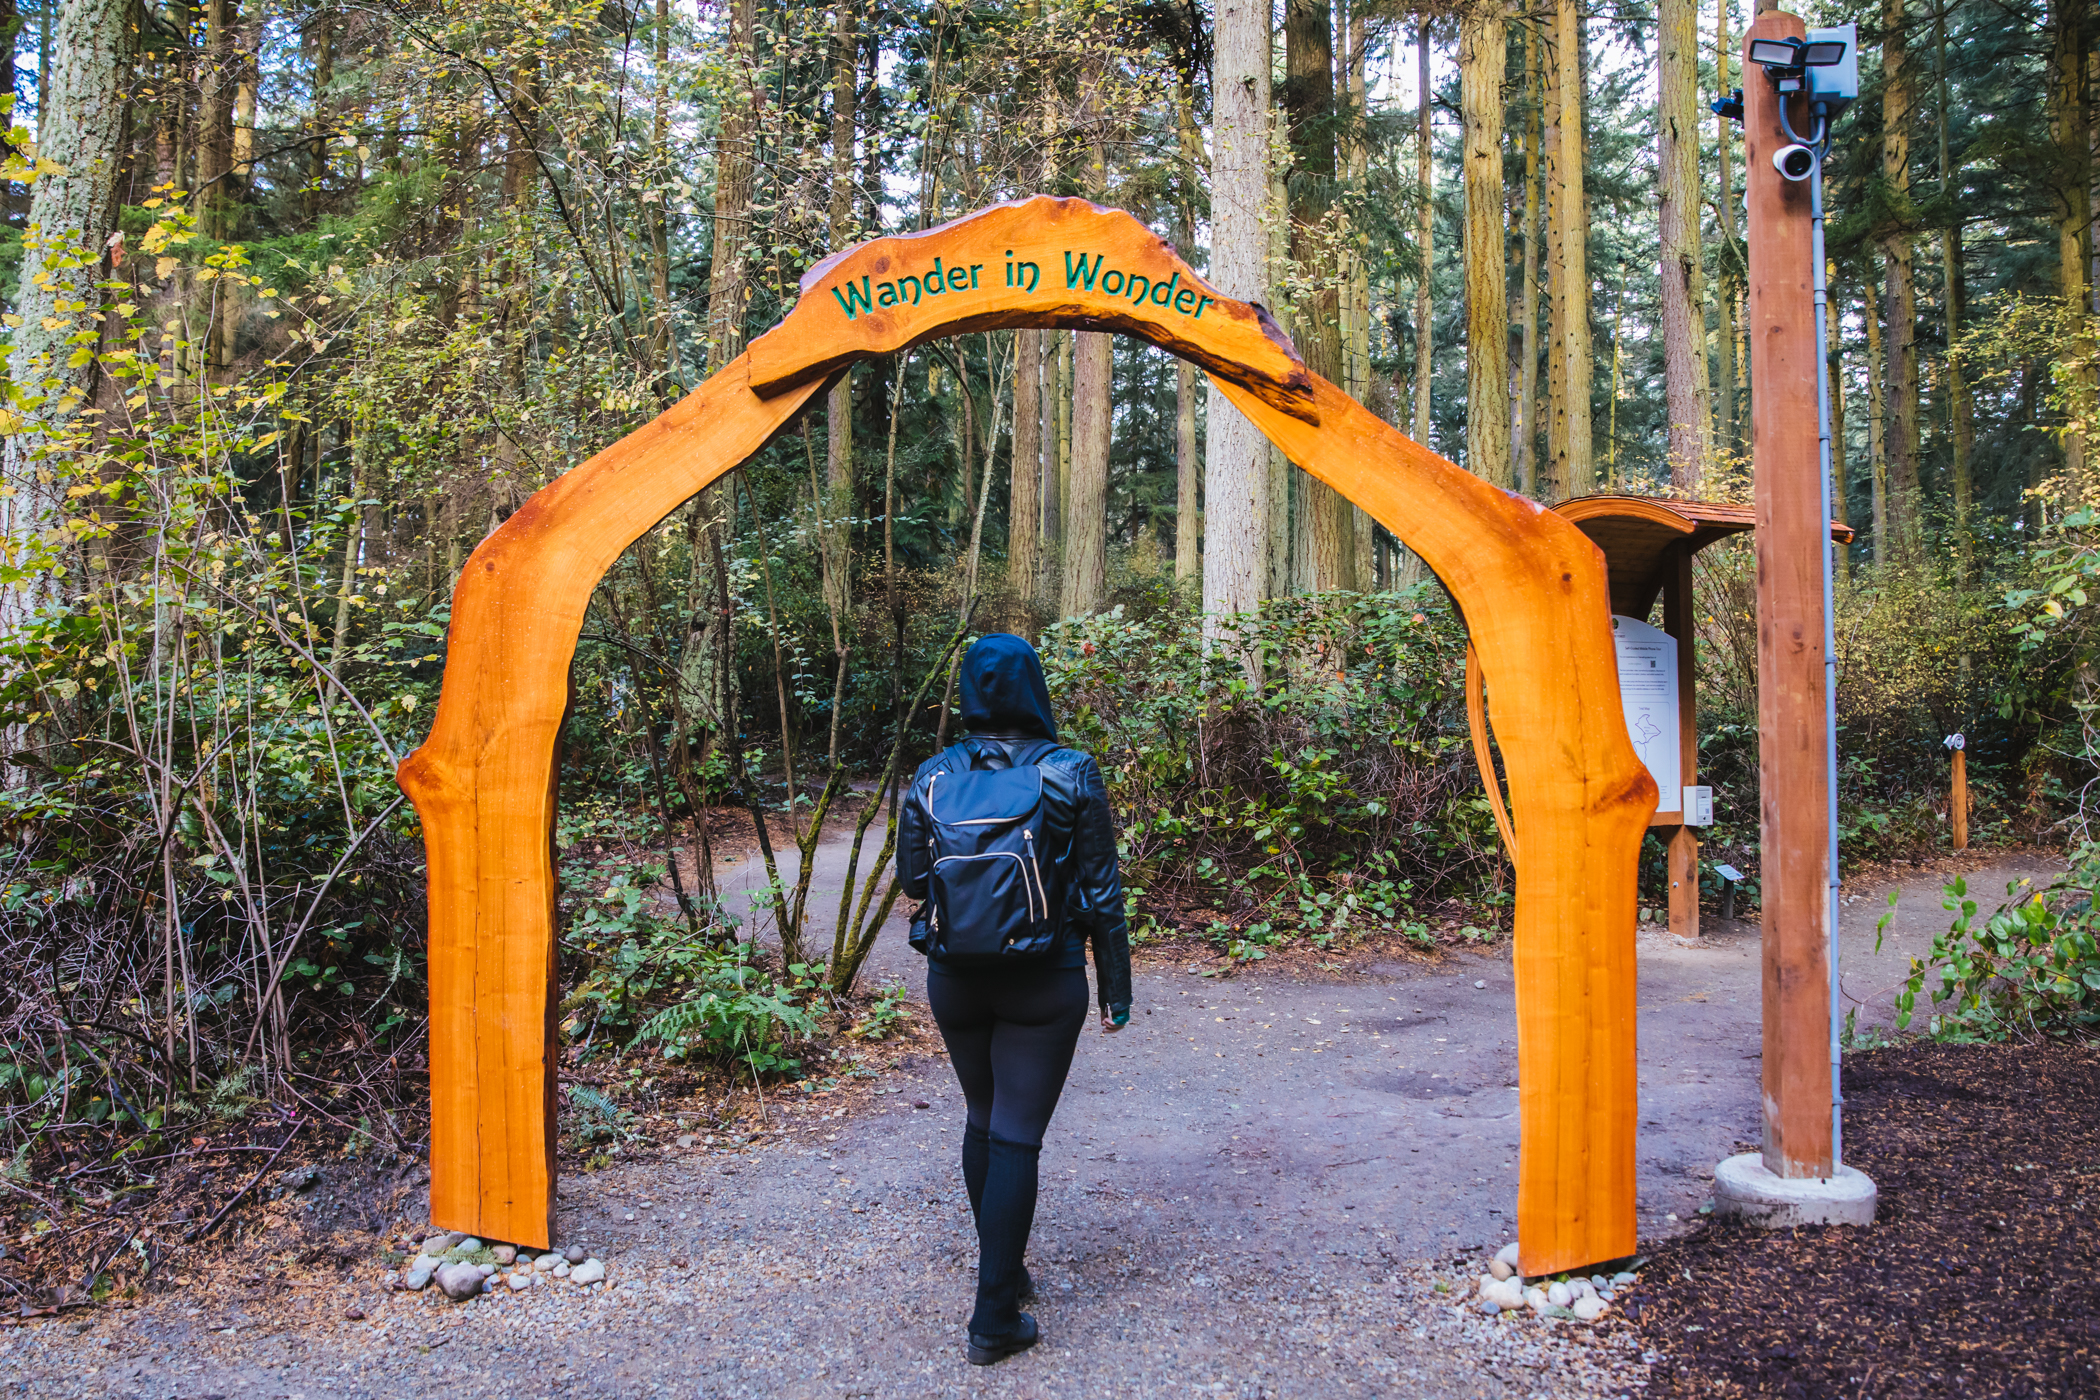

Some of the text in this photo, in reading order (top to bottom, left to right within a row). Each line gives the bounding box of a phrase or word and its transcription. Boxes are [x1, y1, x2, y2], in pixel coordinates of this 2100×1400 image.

[831, 249, 1214, 321] Wander in Wonder
